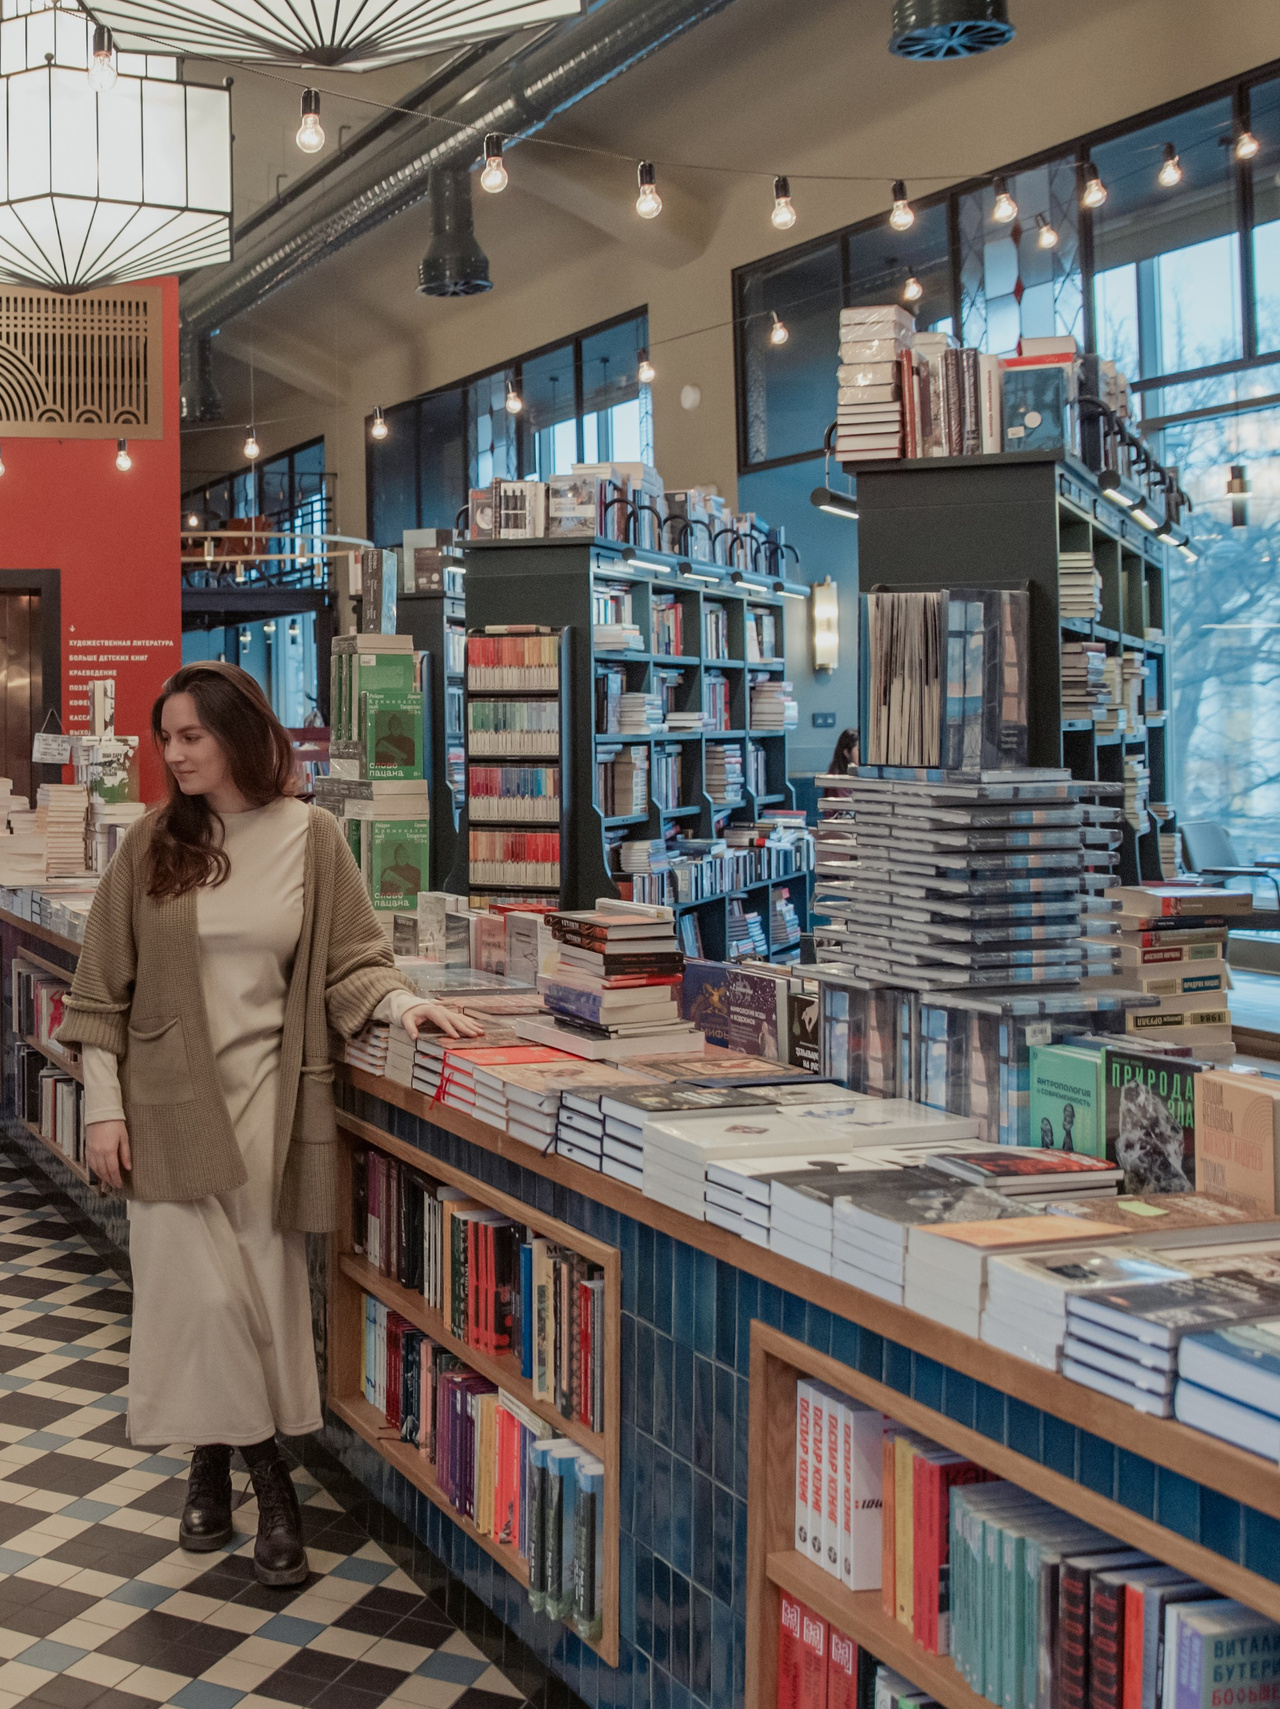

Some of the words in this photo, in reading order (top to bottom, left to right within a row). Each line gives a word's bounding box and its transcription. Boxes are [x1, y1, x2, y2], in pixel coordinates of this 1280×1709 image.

[369, 770, 404, 778] пацана
[374, 899, 410, 908] пацана
[1137, 1017, 1163, 1027] ОРУЭЛЛ
[1200, 1013, 1222, 1022] 1984
[1036, 1076, 1091, 1099] АНТРОПОЛОГИЯ
[1112, 1062, 1195, 1101] ПРИРОДА
[1041, 1088, 1091, 1108] СОВРЕМЕННОСТЬ
[1202, 1079, 1224, 1106] STUDIA
[1167, 1100, 1195, 1129] ЗЛА
